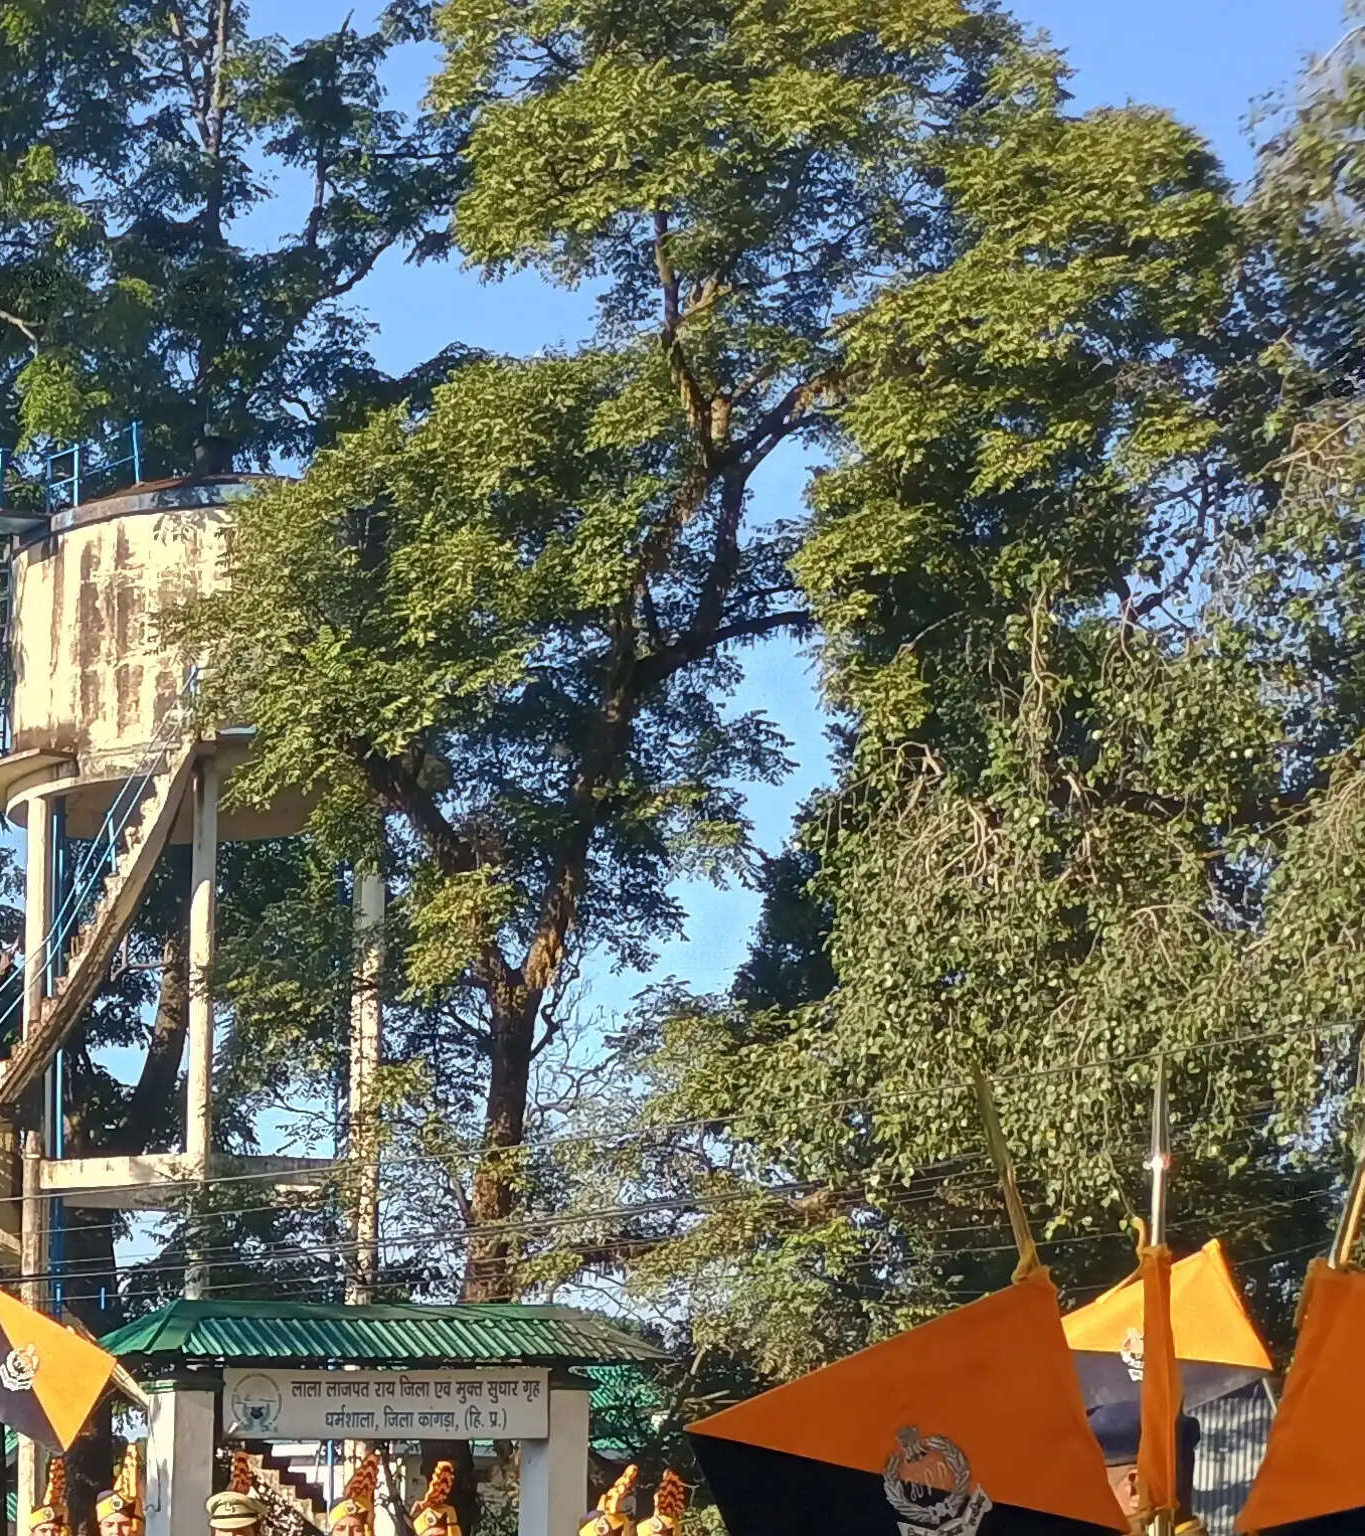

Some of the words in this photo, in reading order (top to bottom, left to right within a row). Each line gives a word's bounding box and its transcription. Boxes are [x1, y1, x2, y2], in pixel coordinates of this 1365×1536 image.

[291, 1381, 322, 1397] लाला
[325, 1381, 370, 1397] लाजपत
[374, 1381, 396, 1397] राय
[399, 1375, 430, 1397] जिला
[434, 1376, 452, 1399] एवं
[456, 1381, 484, 1403] मुक्त
[487, 1381, 519, 1403] सुधार
[522, 1380, 541, 1402] गृह
[325, 1404, 379, 1431] धर्मशाला,
[384, 1405, 414, 1427] जिला
